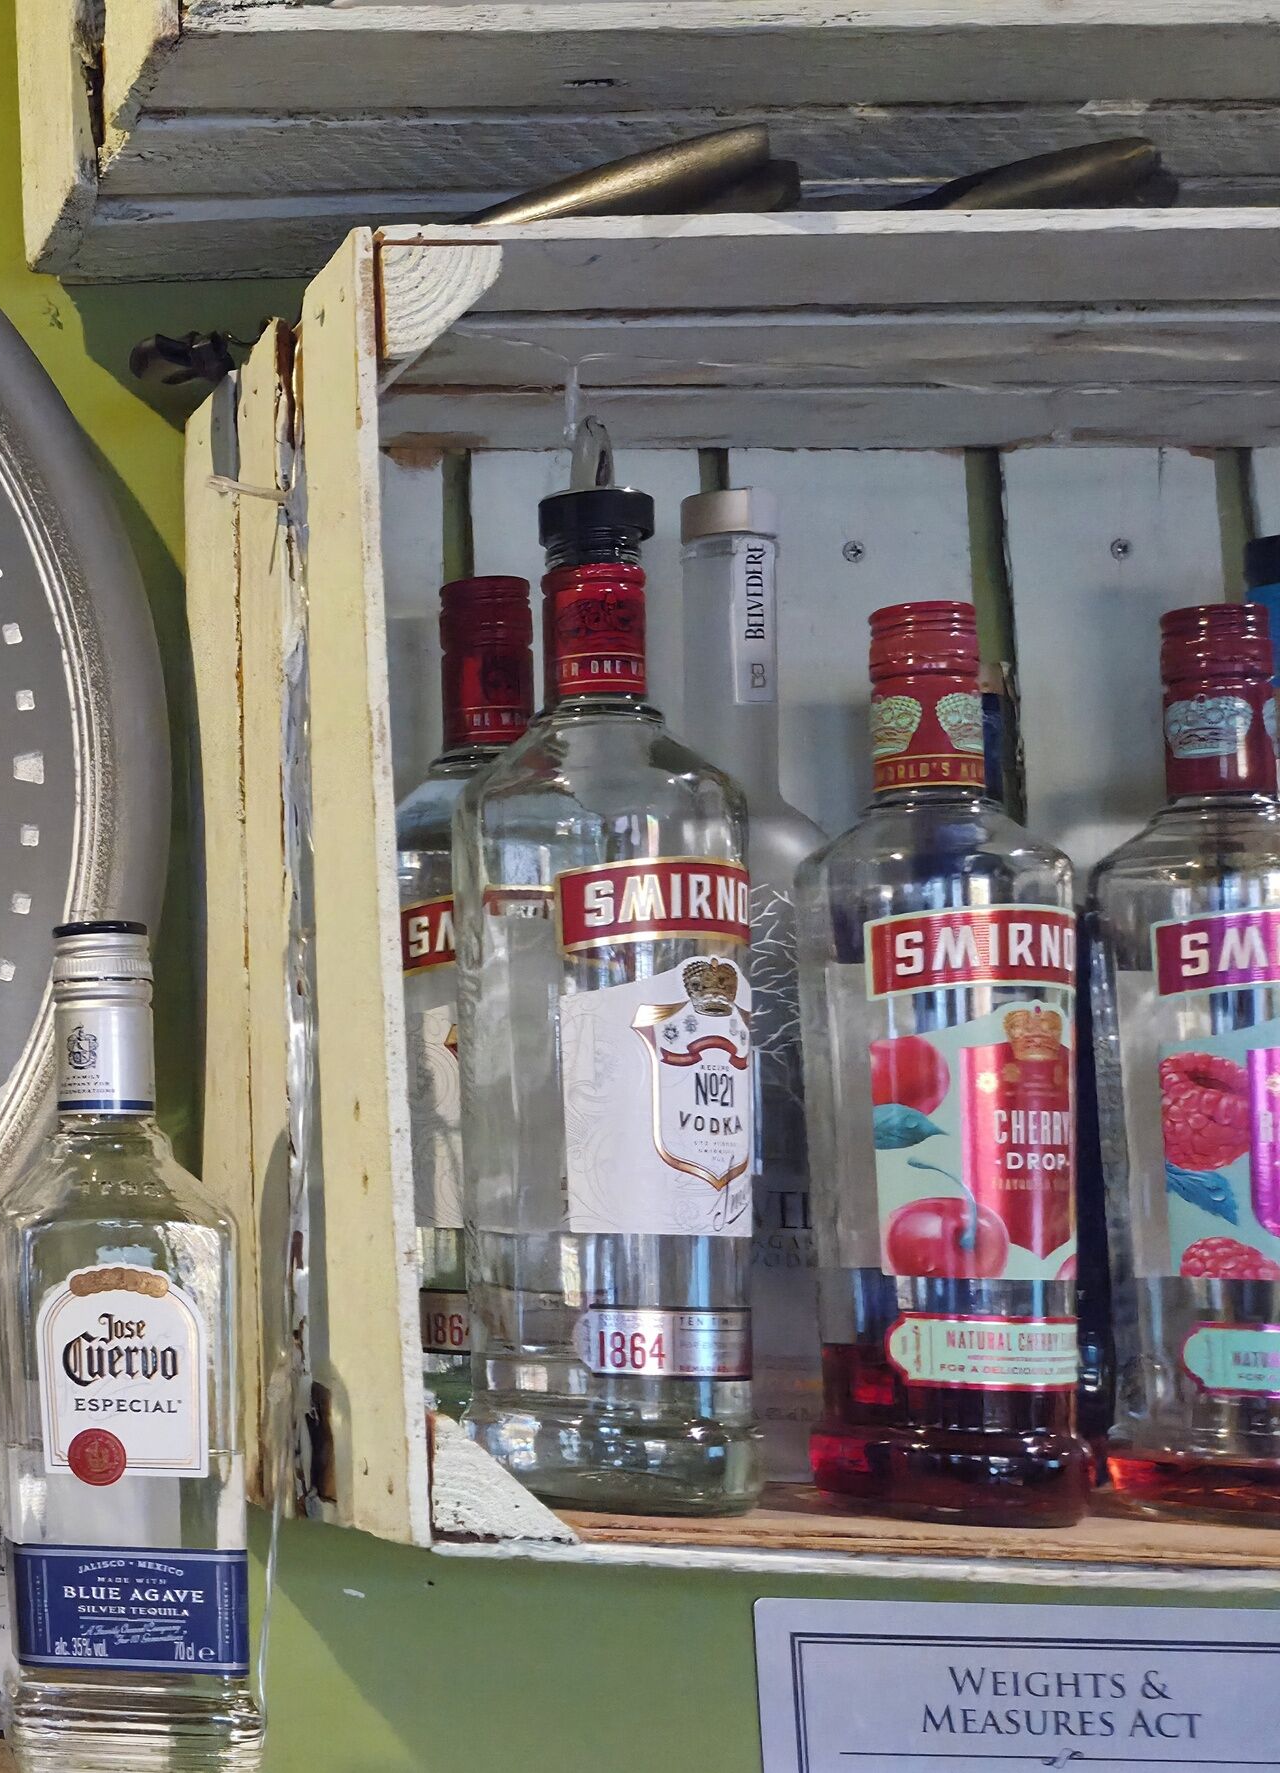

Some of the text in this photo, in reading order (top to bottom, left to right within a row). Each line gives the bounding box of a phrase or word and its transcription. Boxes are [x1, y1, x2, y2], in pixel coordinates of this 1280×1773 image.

[744, 542, 766, 642] BELVEDERE
[583, 872, 750, 926] SMIRNO
[894, 921, 1075, 977] SMIRNO
[678, 1110, 744, 1136] VODKA
[992, 1109, 1073, 1146] CHERRY
[97, 1312, 147, 1345] Jose
[426, 1312, 470, 1346] 186
[945, 1329, 1013, 1351] NATURAL
[62, 1330, 180, 1387] Cuervo
[598, 1330, 666, 1370] 1864
[73, 1397, 180, 1414] ESPECIAL
[77, 1559, 185, 1577] JALISCO MEXICO
[96, 1576, 168, 1585] MADE WITH
[62, 1585, 205, 1604] BLUE AGAVE
[77, 1604, 190, 1617] SILVER TEQUILA
[947, 1665, 1174, 1700] WEIGHTS &
[920, 1703, 1203, 1740] MEASURES ACT
